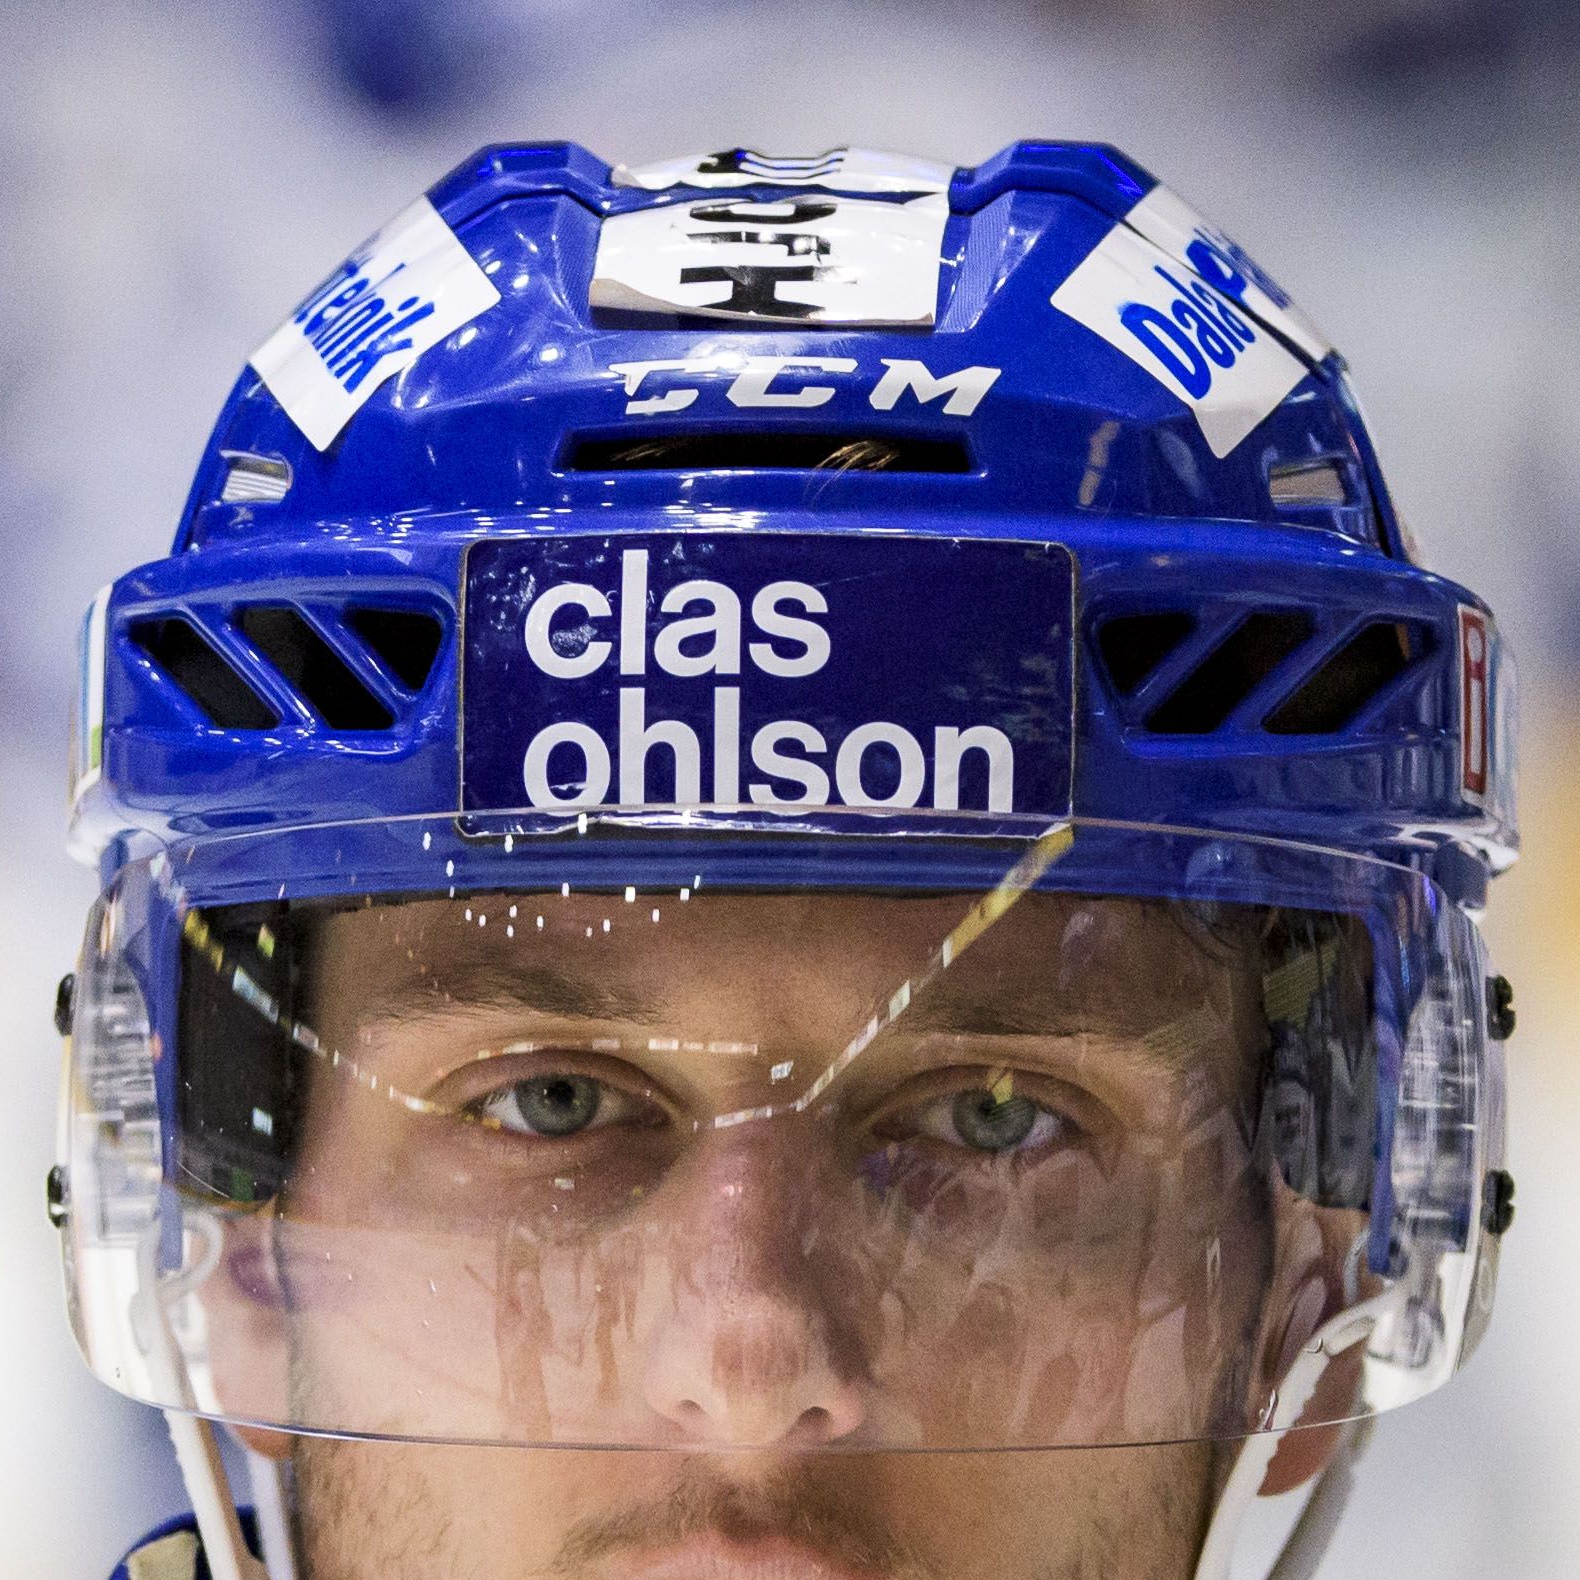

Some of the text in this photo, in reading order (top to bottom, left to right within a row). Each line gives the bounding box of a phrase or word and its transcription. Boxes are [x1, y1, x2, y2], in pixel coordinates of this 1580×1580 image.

[608, 355, 1002, 417] CCM
[524, 548, 831, 679] clas
[523, 686, 1015, 816] ohlson
